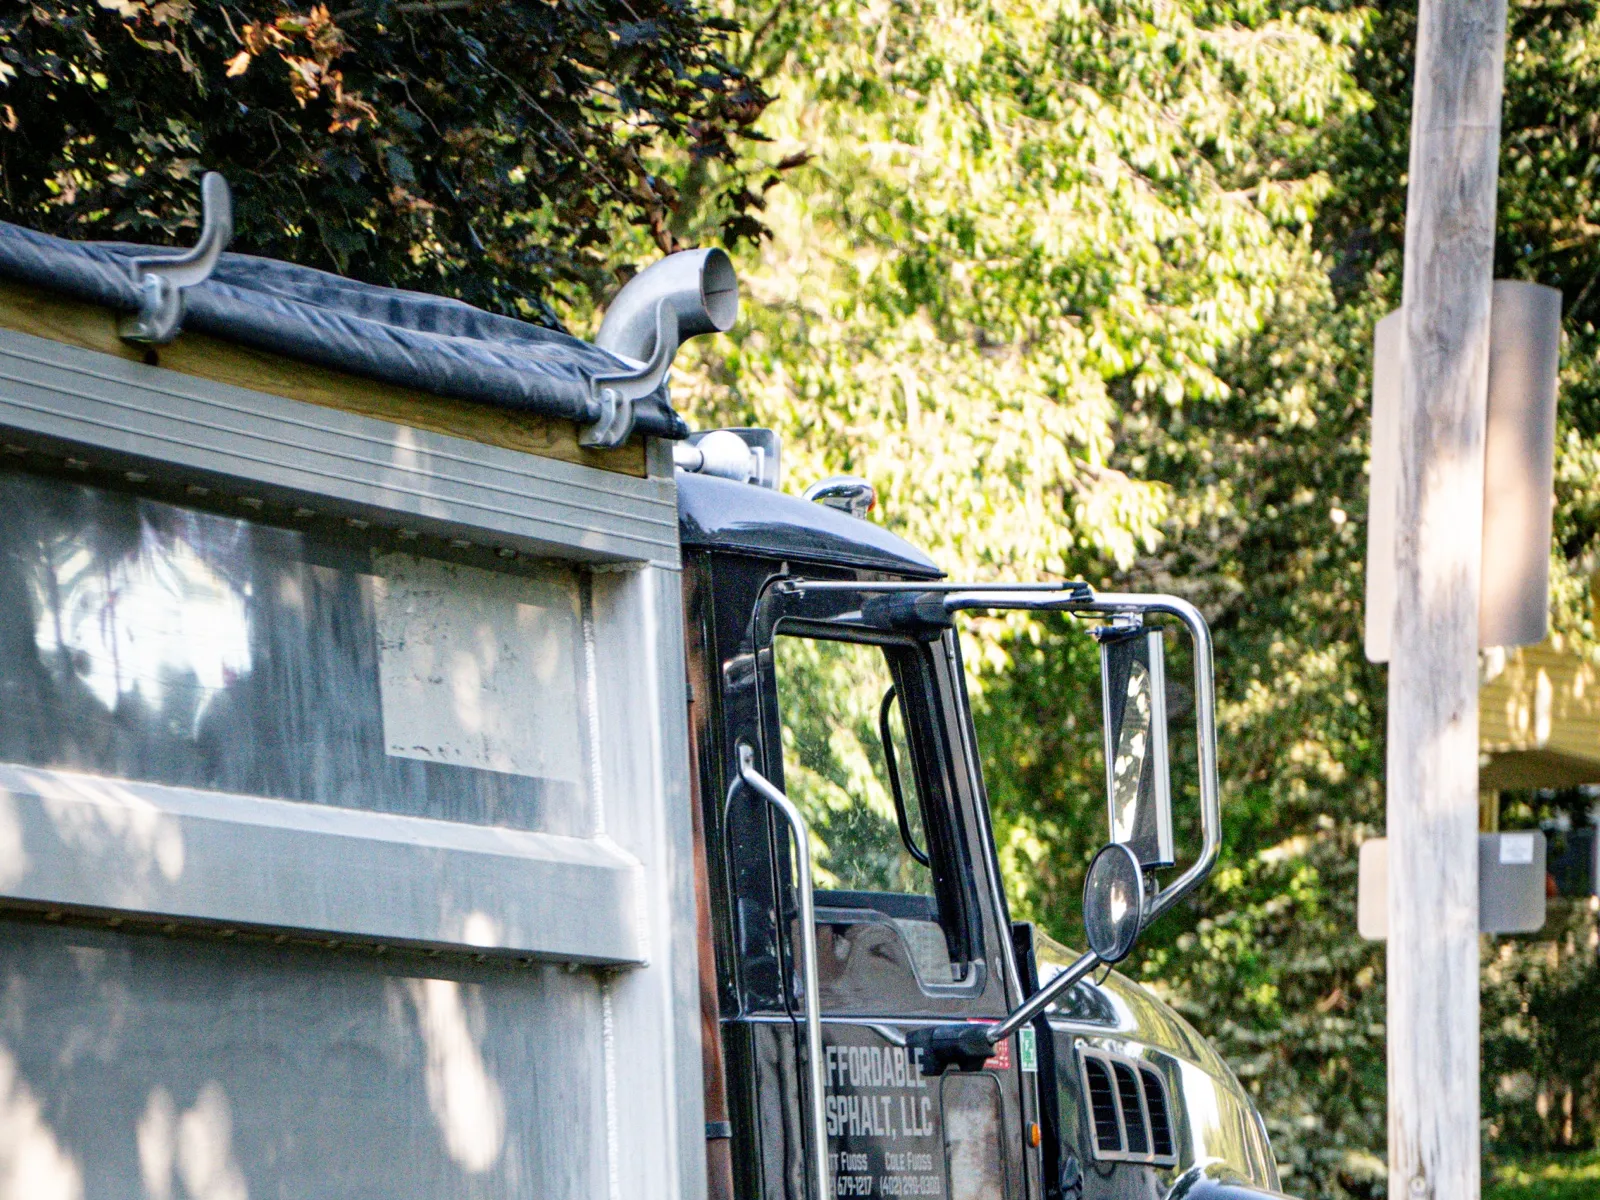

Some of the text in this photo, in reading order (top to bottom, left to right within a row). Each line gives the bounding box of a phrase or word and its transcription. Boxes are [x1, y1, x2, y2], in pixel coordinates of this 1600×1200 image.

[825, 1045, 927, 1088] FFORDABLE
[825, 1095, 933, 1141] SPHALT, LLC
